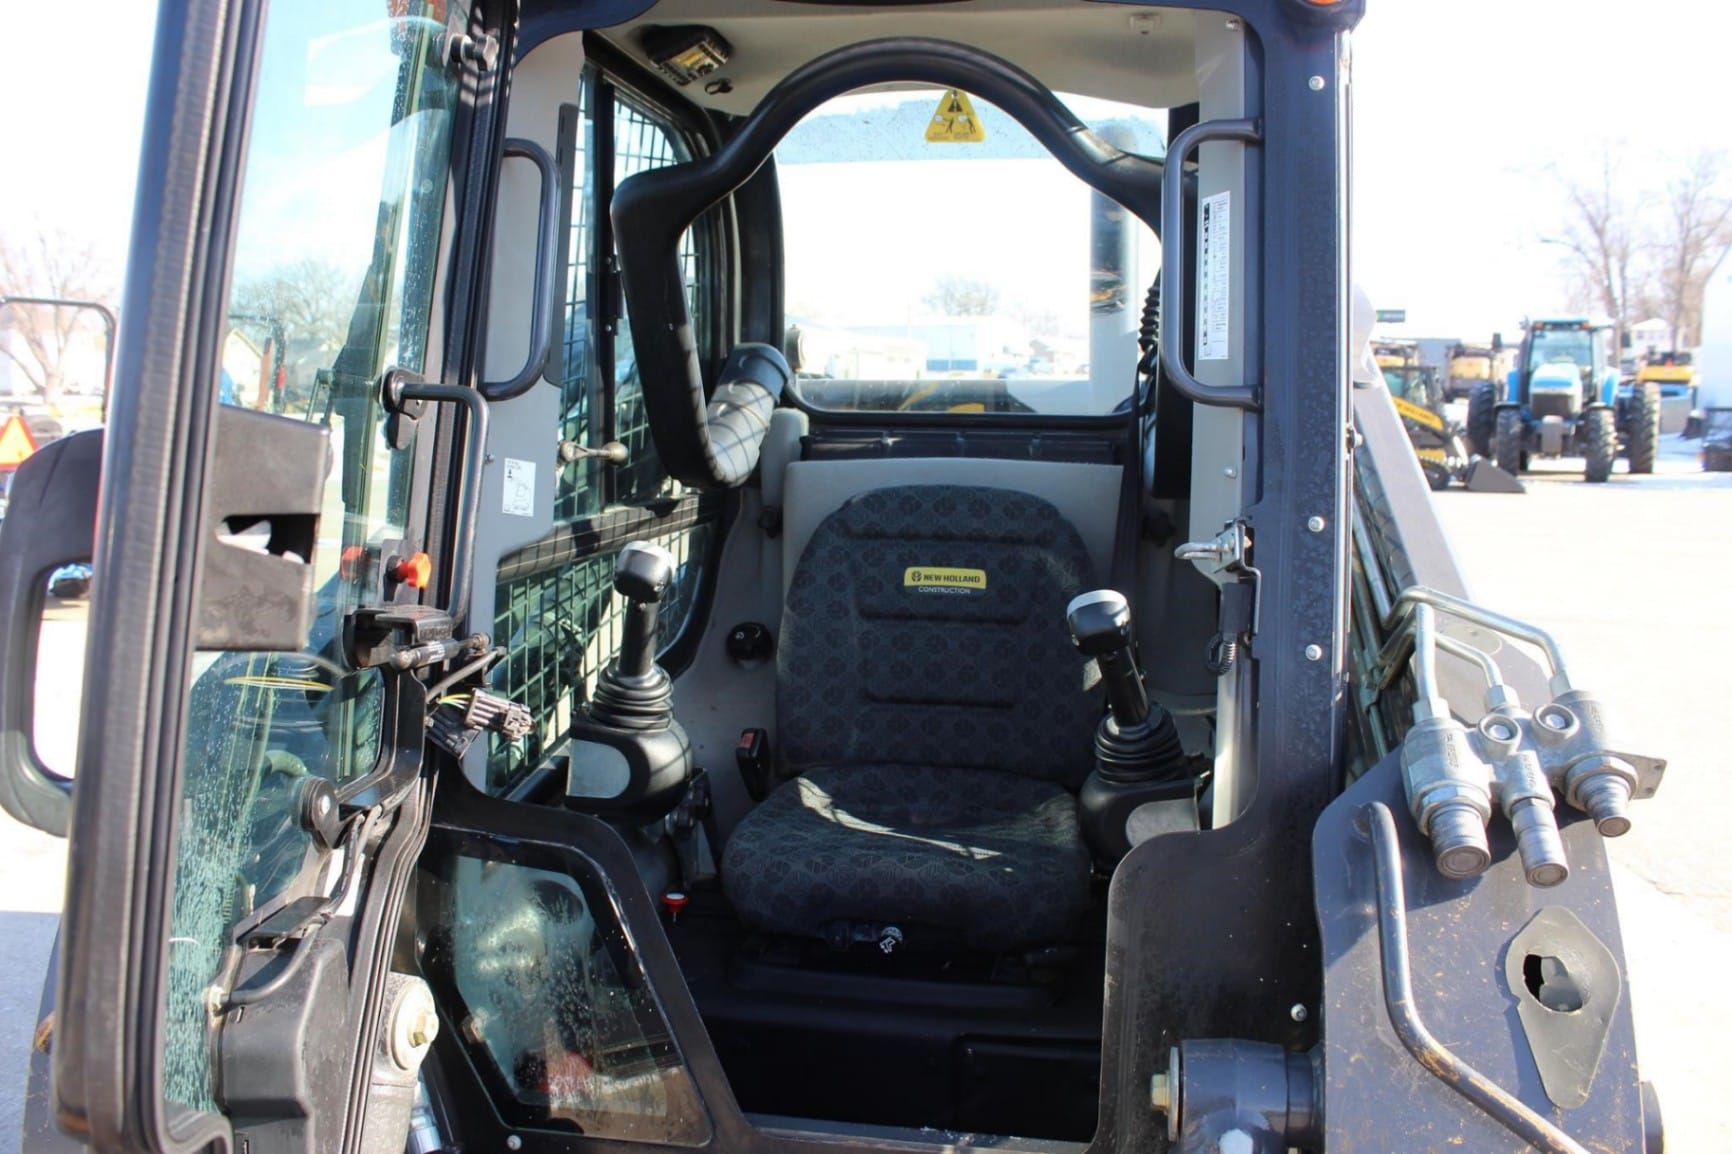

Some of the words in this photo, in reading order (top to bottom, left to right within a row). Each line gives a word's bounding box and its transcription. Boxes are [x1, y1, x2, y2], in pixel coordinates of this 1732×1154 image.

[923, 574, 942, 582] NEW
[943, 574, 980, 583] HOLLAND
[918, 586, 971, 594] CONSTRUCTION
